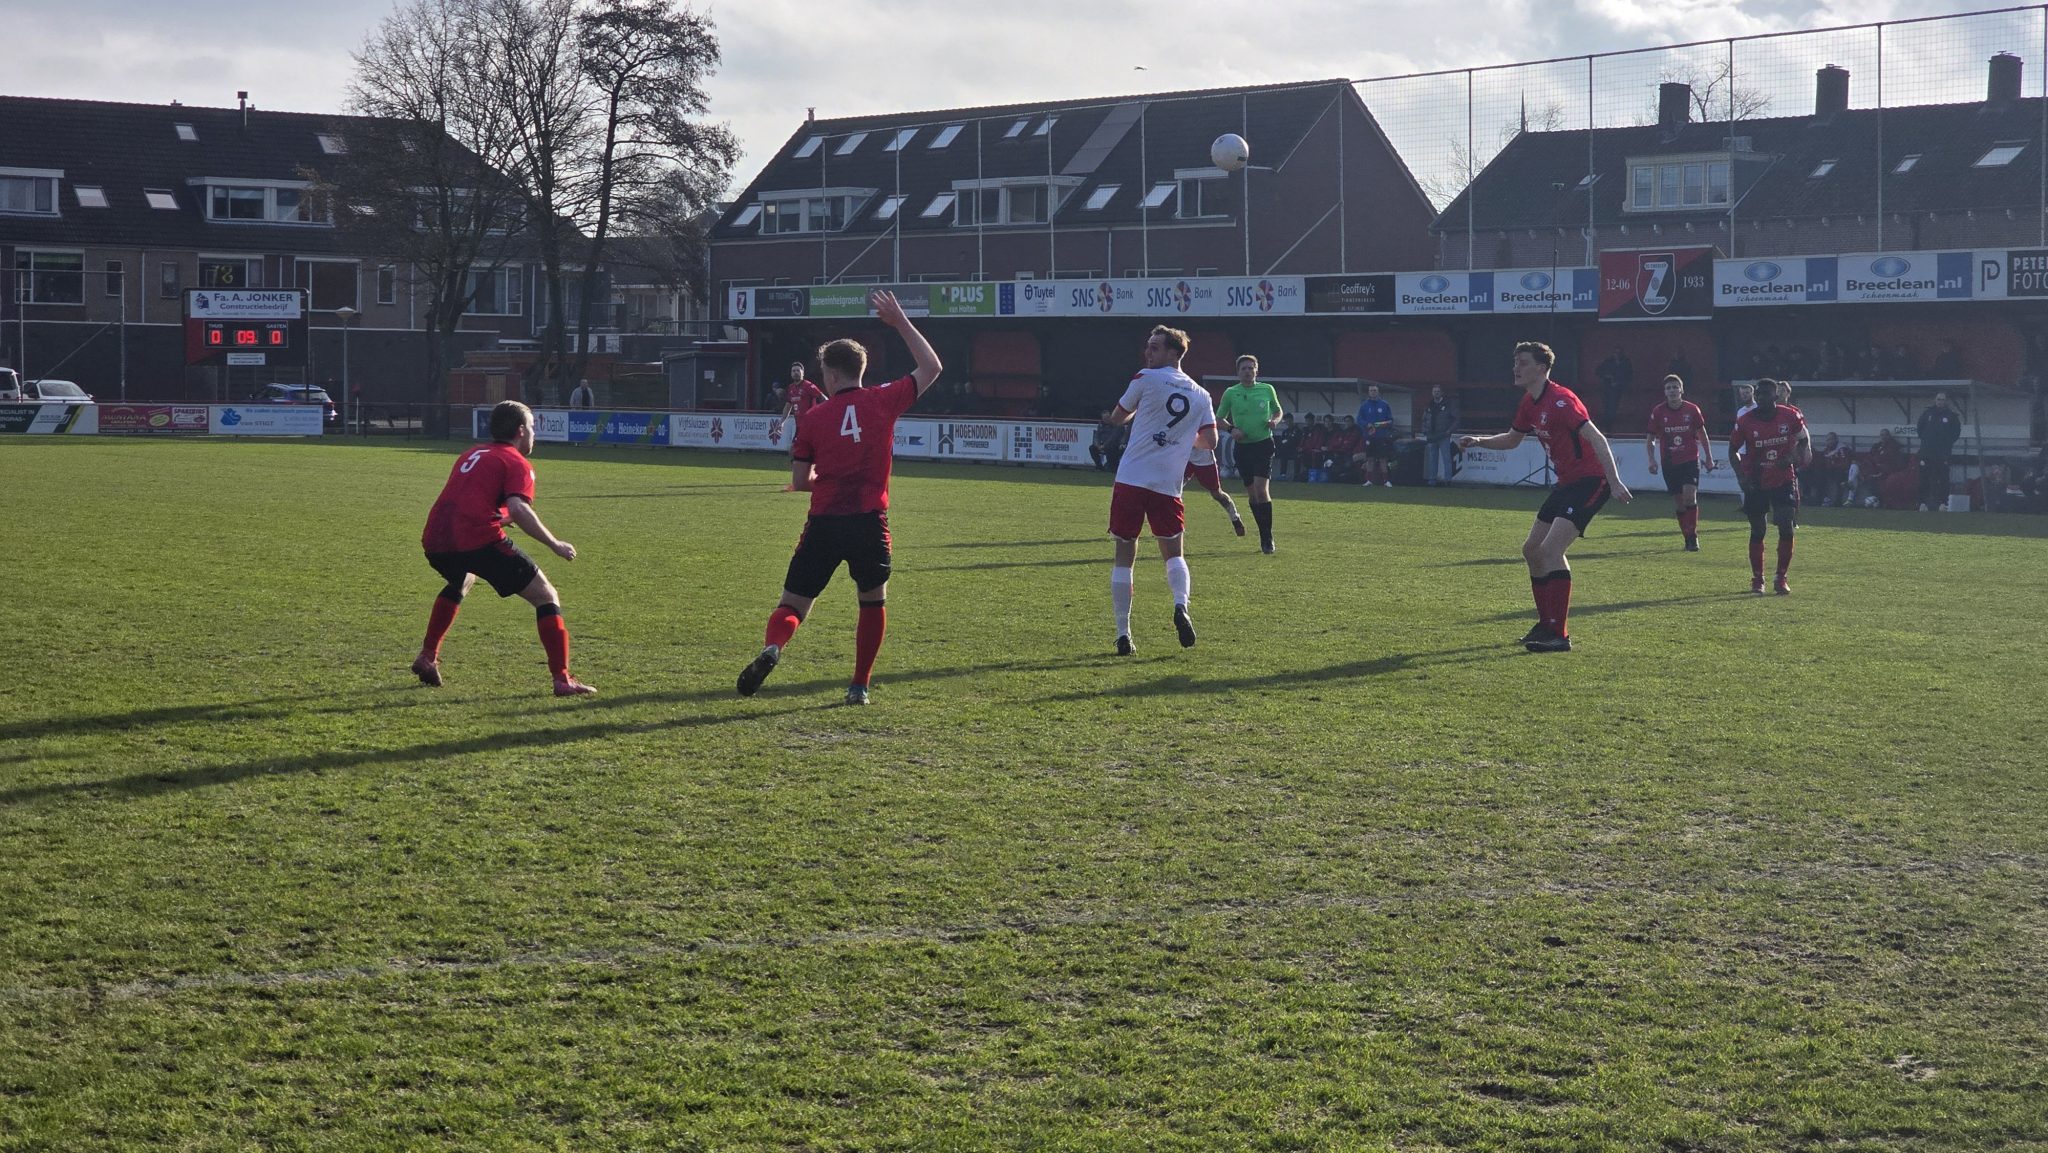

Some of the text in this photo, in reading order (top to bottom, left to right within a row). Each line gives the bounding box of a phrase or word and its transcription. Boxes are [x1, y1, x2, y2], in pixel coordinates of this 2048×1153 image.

[2013, 255, 2048, 271] PETE
[1340, 282, 1376, 296] Geoffrey's
[1606, 277, 1631, 291] 12-06
[1682, 275, 1705, 288] 1933
[213, 293, 293, 302] Fa. A. JONKER
[951, 286, 984, 303] PLUS
[1033, 285, 1056, 300] Tuytel
[1071, 287, 1134, 308] SNS Bank
[1147, 286, 1213, 308] SNS Bank
[1227, 285, 1298, 307] SNS Bank
[219, 302, 288, 311] Constructiebedrijf
[210, 329, 221, 345] 0
[271, 329, 282, 345] 0
[1165, 392, 1190, 429] 9
[569, 421, 597, 433] Heineken
[618, 422, 648, 435] Heineken
[678, 417, 709, 431] Vijfsluizen
[734, 418, 767, 432] Vijfsluizen
[840, 404, 862, 443] 4
[954, 424, 998, 440] HOGENDOORN
[1035, 427, 1079, 443] HOGENDOORN
[459, 449, 491, 473] 5
